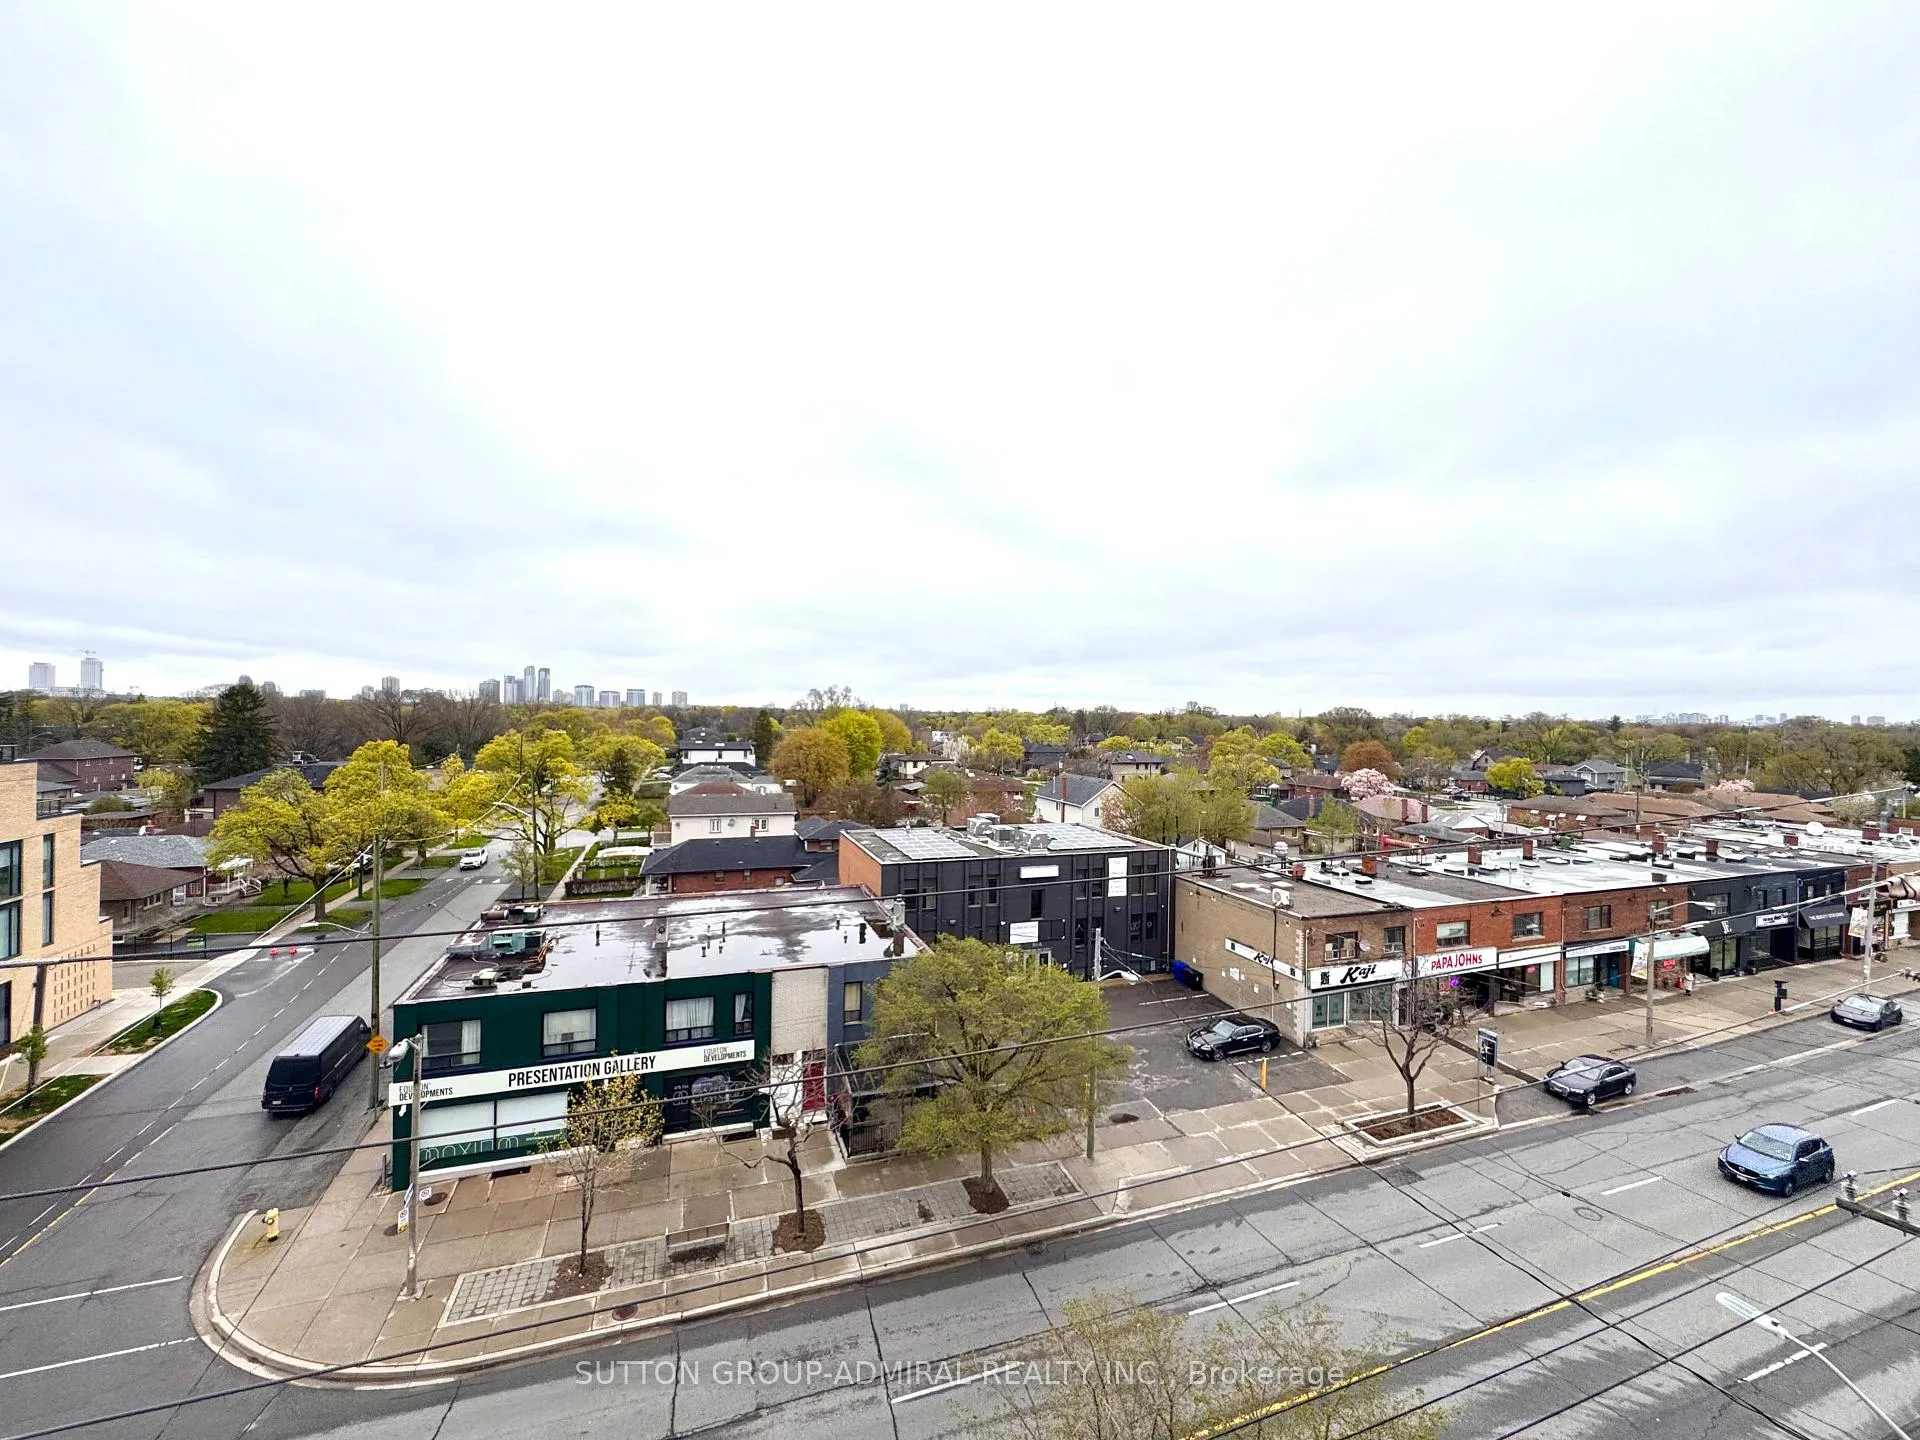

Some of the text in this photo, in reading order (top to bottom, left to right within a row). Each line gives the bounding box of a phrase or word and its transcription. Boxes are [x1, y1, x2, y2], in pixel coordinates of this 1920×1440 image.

[1340, 964, 1377, 984] Kaji
[703, 1050, 747, 1063] DEVELOPMENTS
[508, 1055, 656, 1088] PRESENTATION GALLERY
[399, 1087, 453, 1101] DEVOPMENTS
